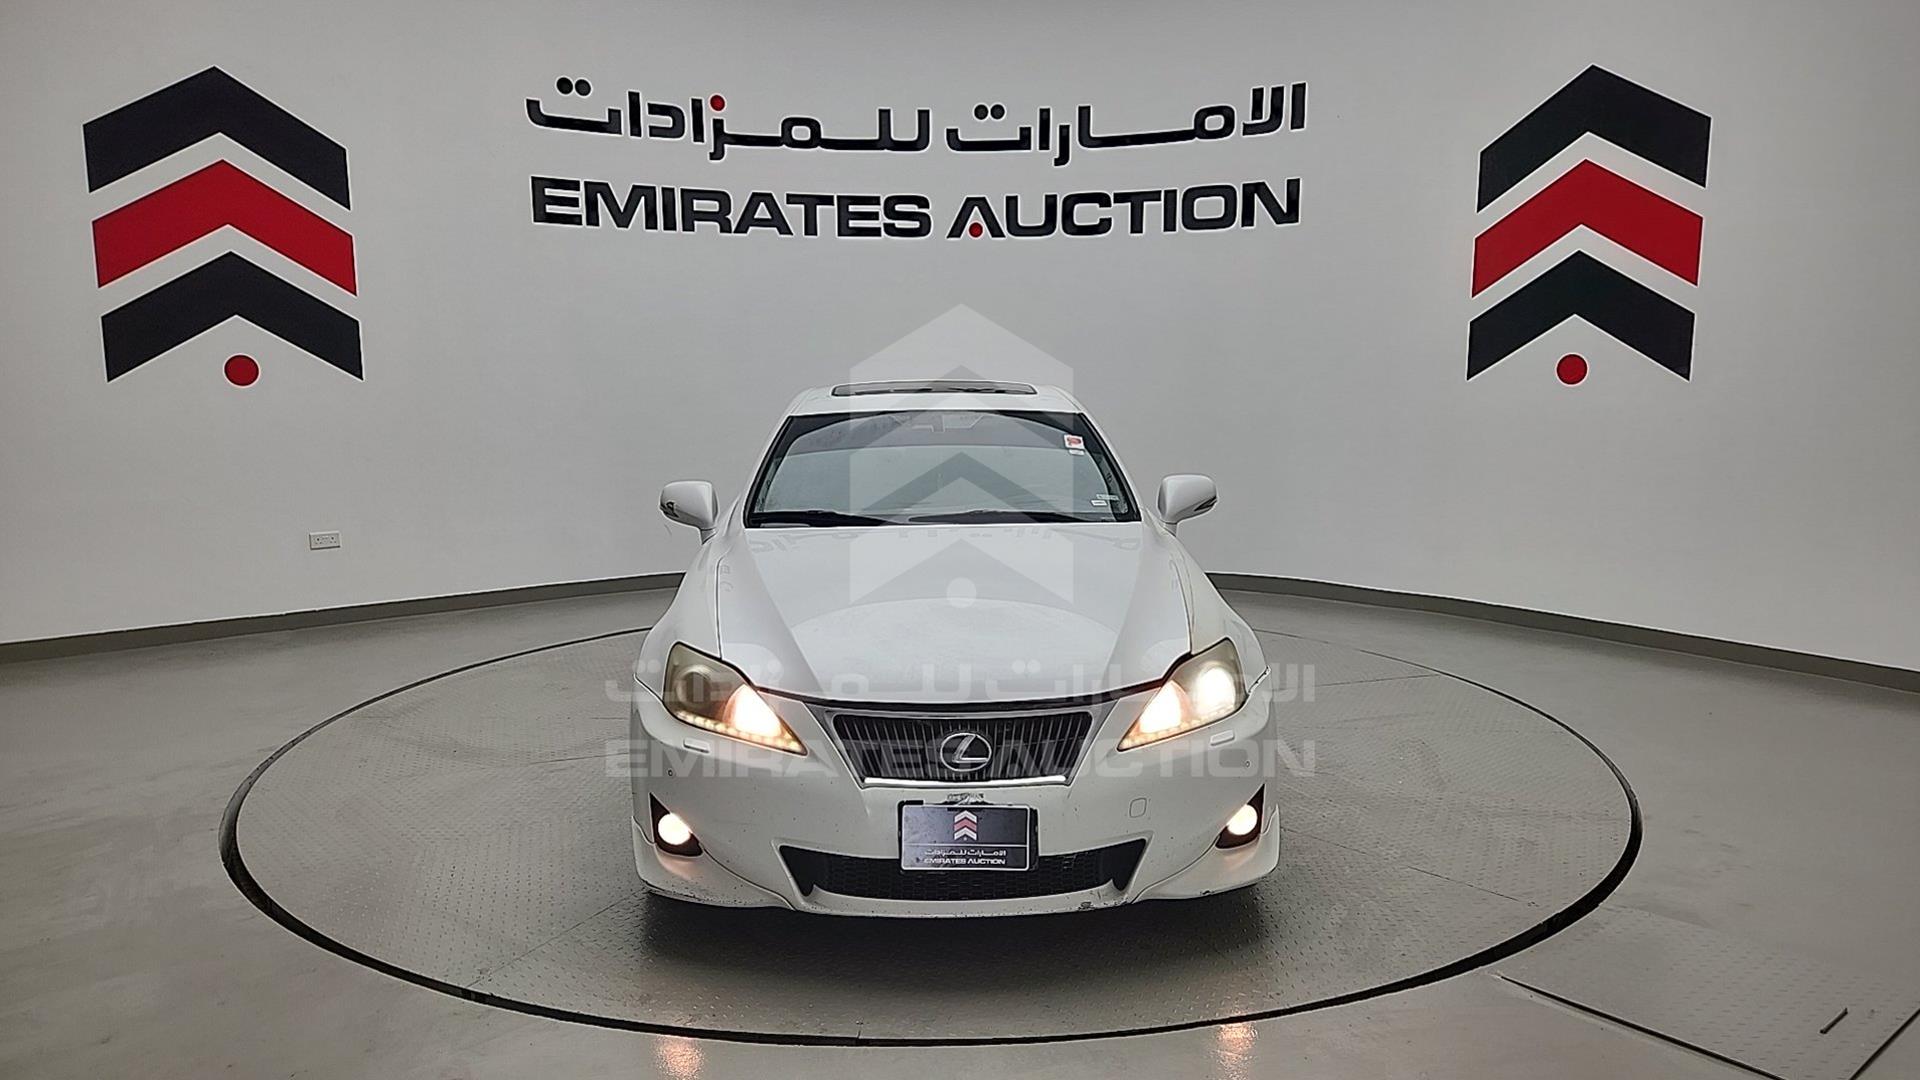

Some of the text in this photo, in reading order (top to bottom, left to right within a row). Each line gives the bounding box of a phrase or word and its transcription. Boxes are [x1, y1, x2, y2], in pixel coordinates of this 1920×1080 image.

[525, 76, 1307, 167] الامارات للمزادات
[531, 176, 1301, 239] EMIRATES AUCTION
